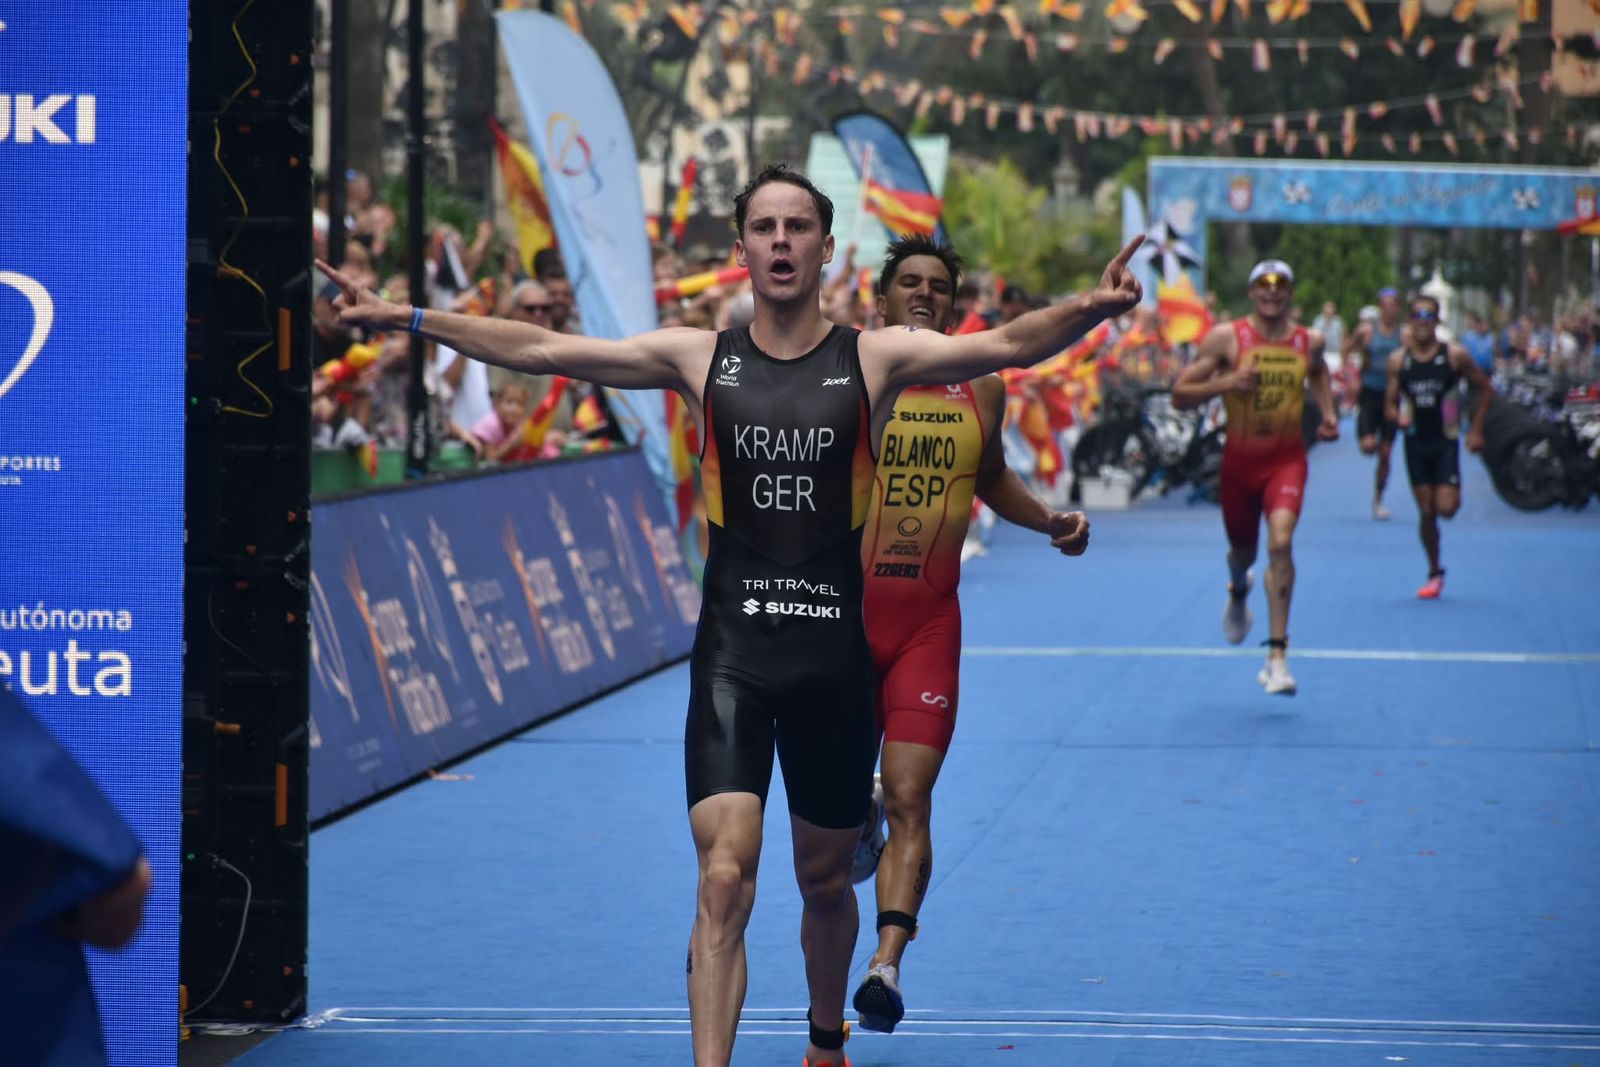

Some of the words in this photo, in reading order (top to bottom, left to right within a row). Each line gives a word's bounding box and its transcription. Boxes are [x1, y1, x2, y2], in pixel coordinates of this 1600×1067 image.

[0, 94, 97, 144] KI
[900, 411, 963, 423] SUZUKI
[734, 424, 835, 462] KRAMP
[883, 433, 956, 470] BLANCO
[752, 473, 816, 512] GER
[884, 473, 945, 508] ESP
[742, 579, 769, 591] TRI
[774, 578, 840, 597] TRAVEL
[0, 601, 133, 631] utónoma
[765, 601, 841, 619] SUZUKI
